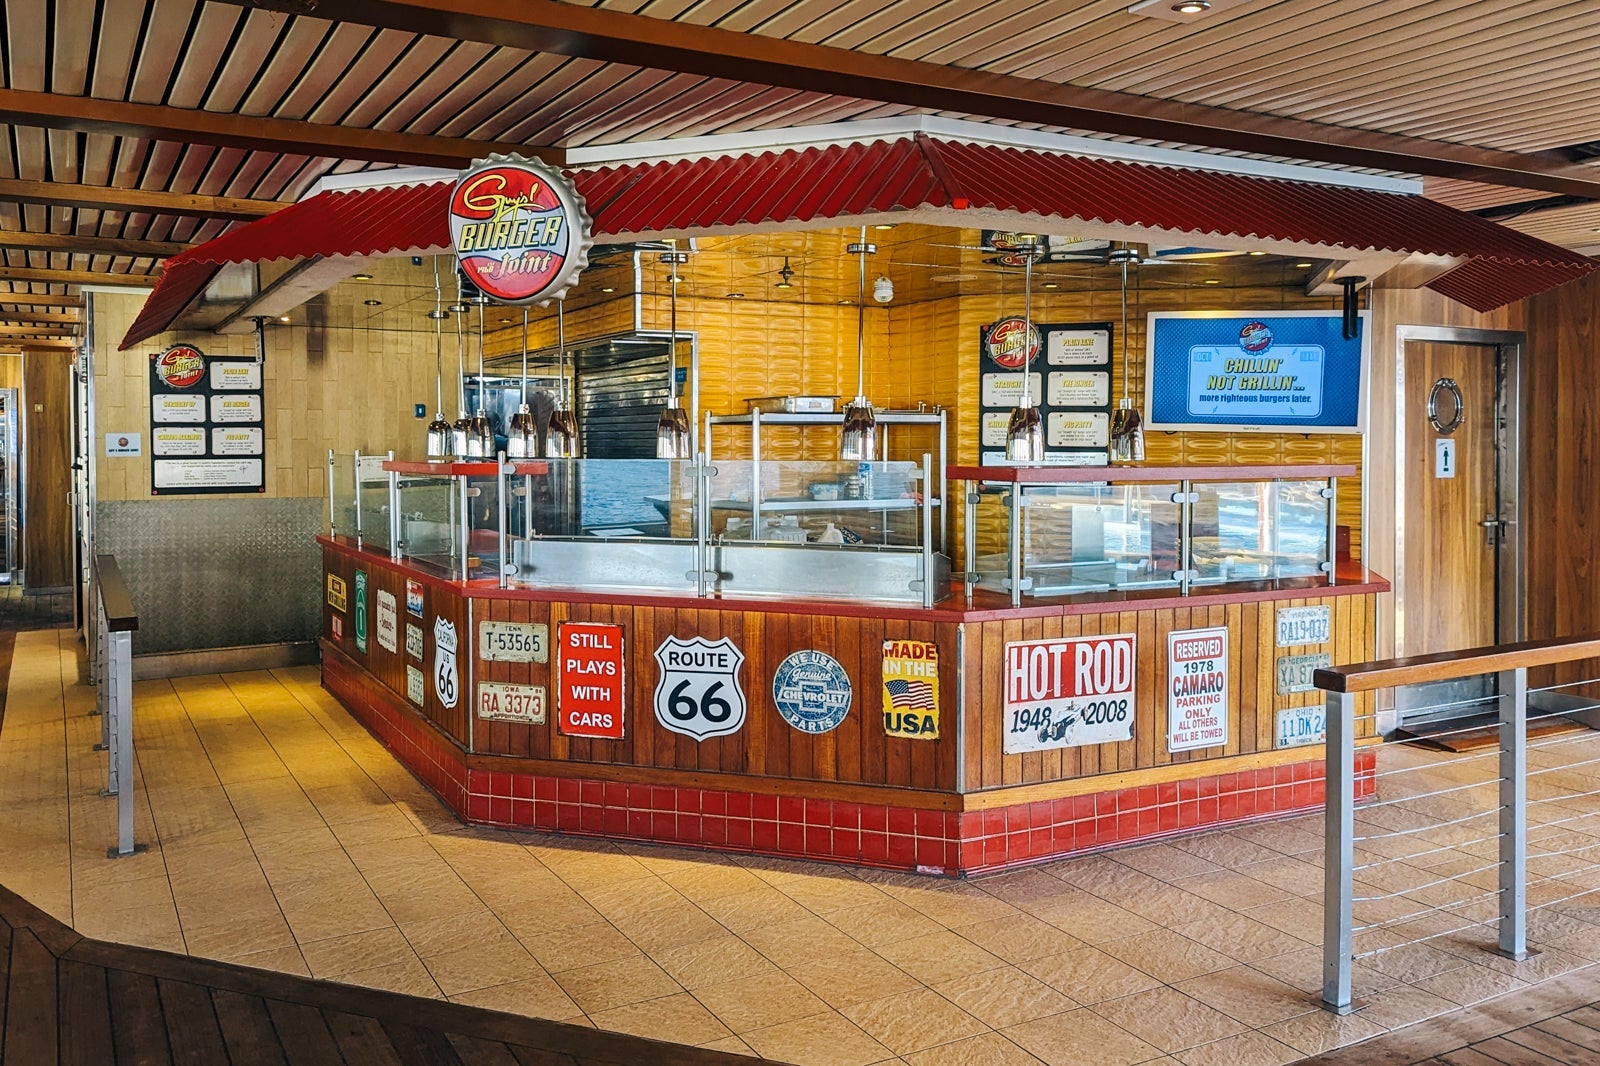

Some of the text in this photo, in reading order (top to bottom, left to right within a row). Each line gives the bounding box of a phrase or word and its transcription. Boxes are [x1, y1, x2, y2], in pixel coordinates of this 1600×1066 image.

[464, 174, 545, 222] Guy's!
[458, 216, 563, 252] BURGER
[490, 252, 552, 280] Joint
[164, 358, 200, 376] BURGER
[1224, 359, 1284, 373] CHILLIN'
[1207, 376, 1236, 390] NOT
[1220, 394, 1258, 403] righteous
[1260, 394, 1290, 403] burgers
[1292, 394, 1312, 403] later.
[486, 632, 540, 652] T-53565
[570, 634, 613, 649] STILL
[1176, 639, 1220, 659] RESERVED
[442, 654, 450, 664] US
[669, 651, 728, 668] ROUTE
[884, 643, 936, 660] MADE
[1291, 656, 1319, 664] GEORGIA
[566, 659, 616, 676] PLAYS
[788, 653, 836, 670] WE USE
[884, 660, 936, 677] IN THE
[1184, 660, 1214, 674] 1978
[1010, 640, 1132, 702] HOT ROD
[1281, 666, 1295, 687] XA
[438, 663, 453, 699] 66
[1173, 672, 1224, 697] CAMARO
[572, 686, 611, 702] WITH
[668, 679, 732, 722] 66
[784, 690, 842, 703] CHEVROLET
[1176, 694, 1220, 708] PARKING
[482, 692, 541, 715] RA 3373
[570, 711, 613, 728] CARS
[1010, 699, 1128, 734] 1948 2008
[1185, 707, 1212, 719] ONLY
[1296, 709, 1313, 717] OHIO
[790, 714, 834, 731] PARTS
[885, 712, 936, 734] USA
[1178, 717, 1218, 730] ALL OTHERS
[1173, 728, 1223, 744] WILL BE TOWED
